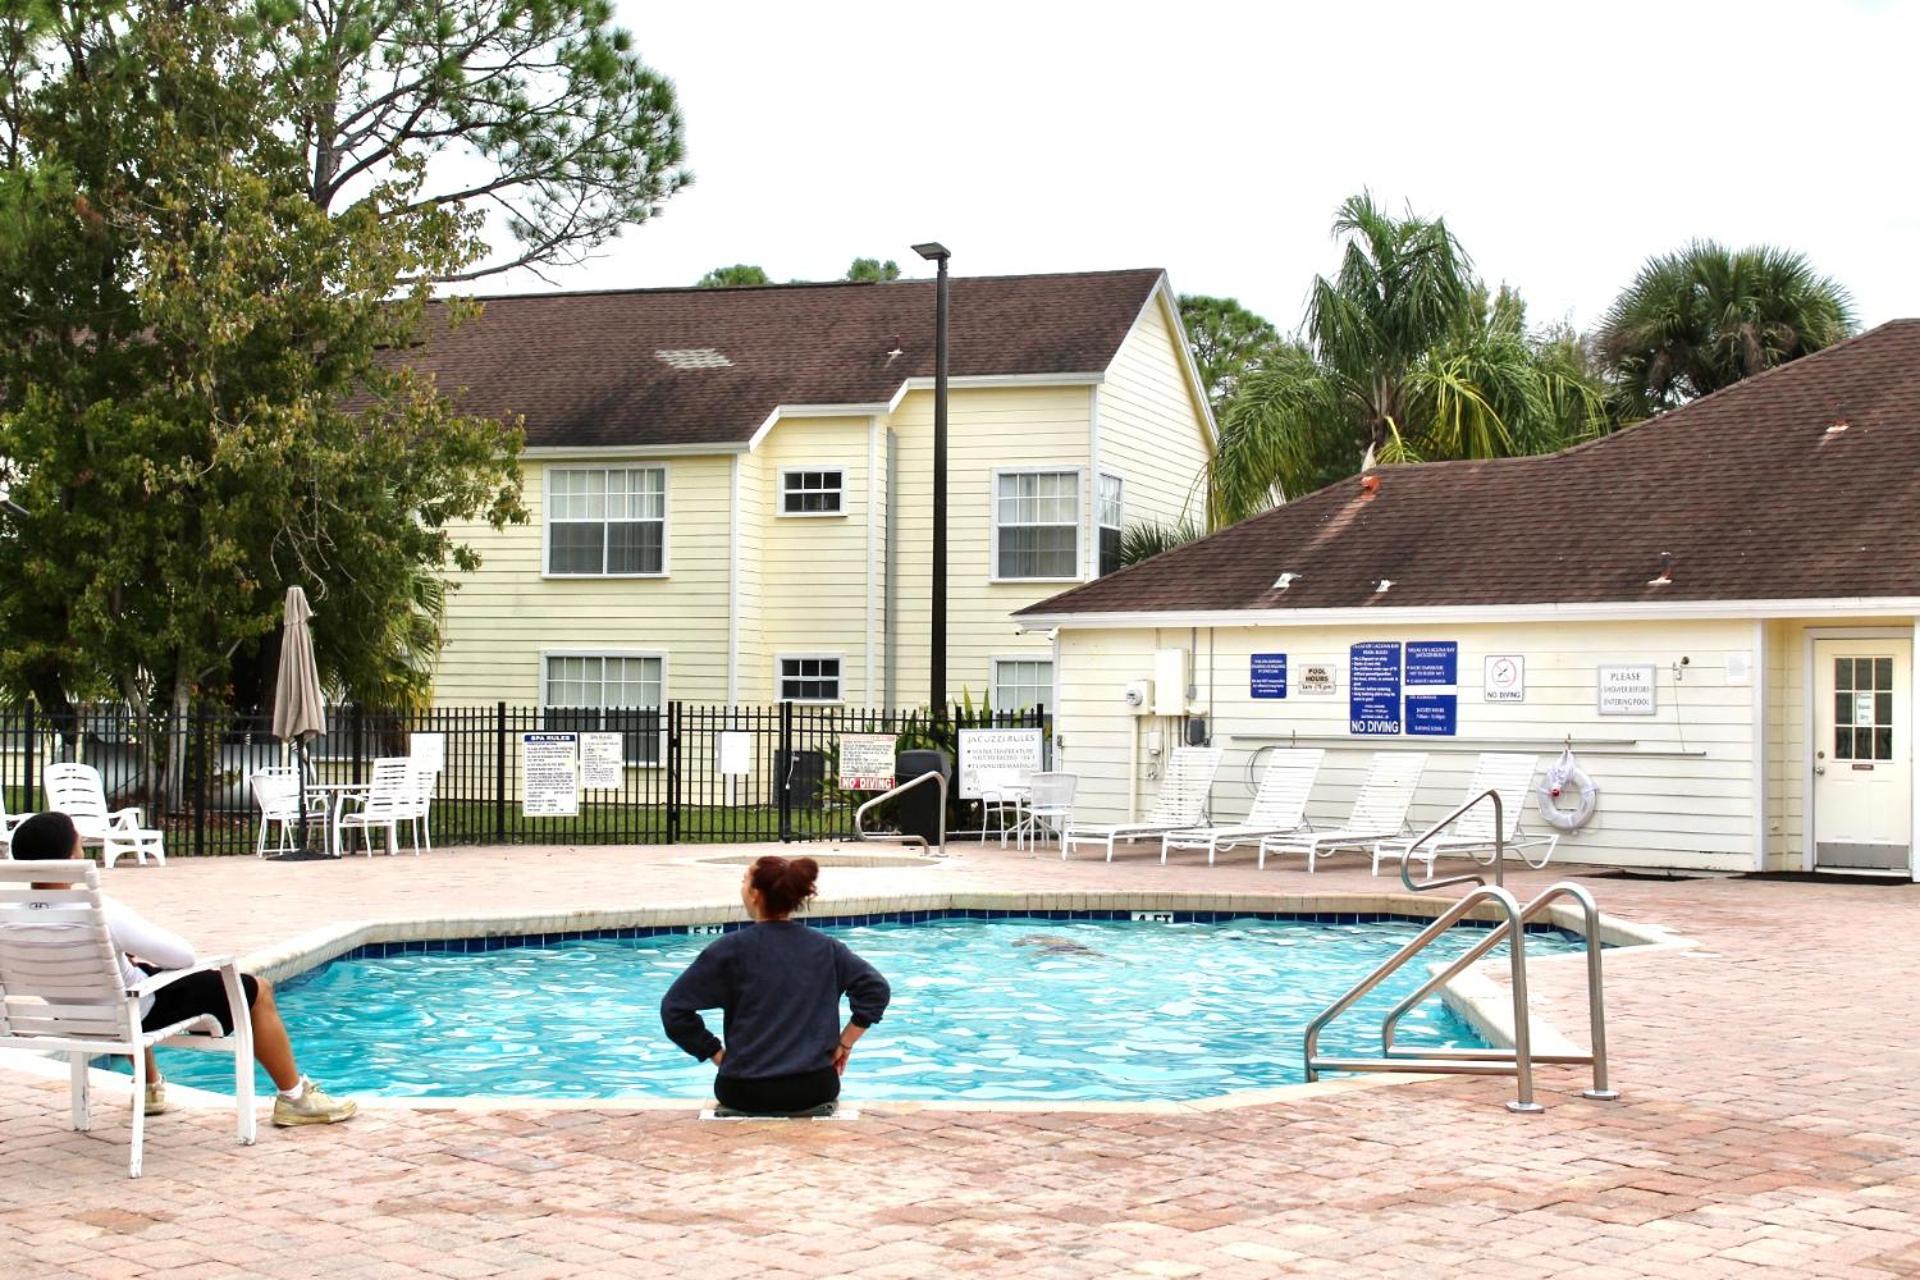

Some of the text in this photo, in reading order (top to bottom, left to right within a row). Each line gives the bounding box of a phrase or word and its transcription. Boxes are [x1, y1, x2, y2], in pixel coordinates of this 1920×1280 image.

[1610, 672, 1641, 681] PLEASE
[1351, 720, 1399, 733] NO DIVING
[967, 734, 1035, 744] JACUZZI RULES
[841, 777, 892, 789] NO DIVING
